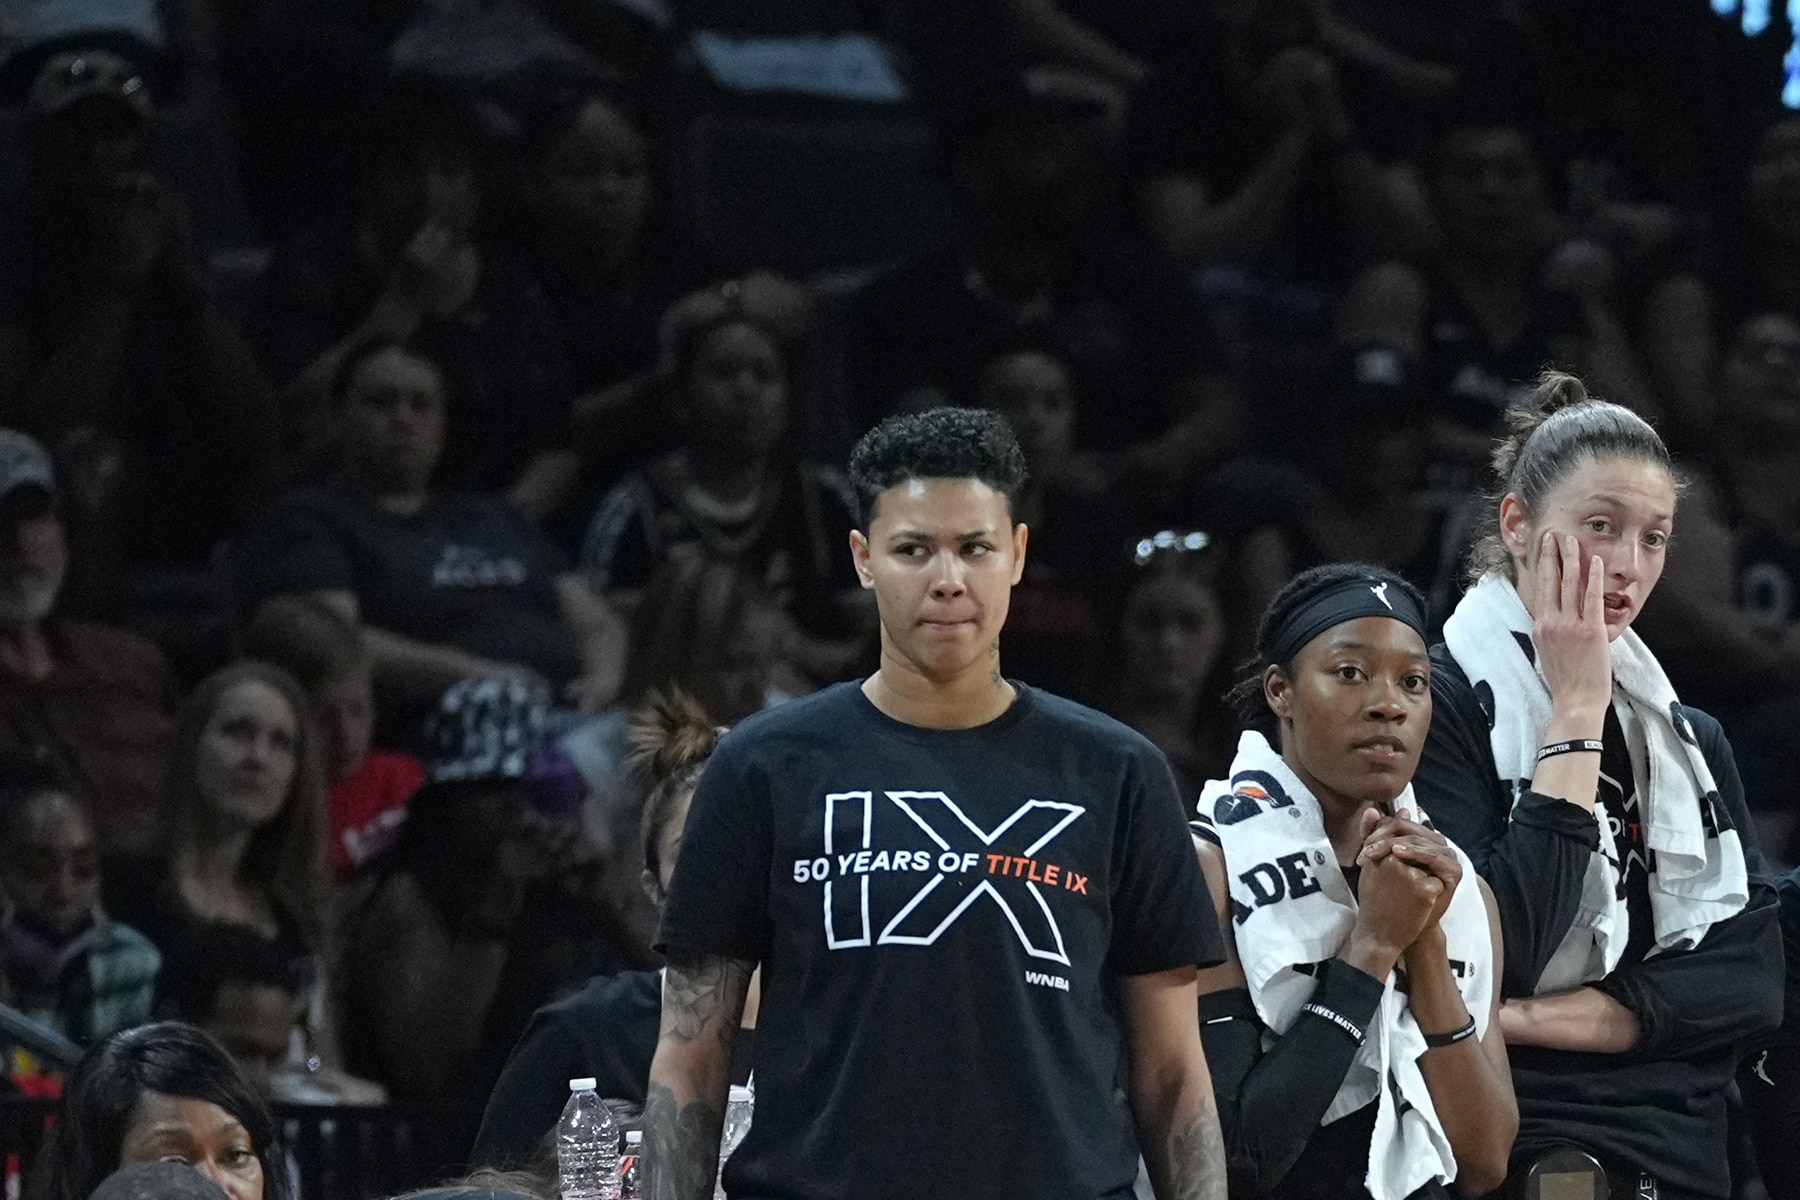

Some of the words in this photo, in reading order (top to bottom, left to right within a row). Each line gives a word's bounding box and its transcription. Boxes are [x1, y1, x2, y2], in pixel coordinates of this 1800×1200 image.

[793, 857, 830, 883] 50
[837, 850, 932, 876] YEARS
[938, 852, 980, 874] OF
[986, 853, 1061, 887] TITLE
[1065, 871, 1089, 895] IX
[1025, 970, 1069, 992] WNBA
[1311, 1004, 1335, 1019] LIVES
